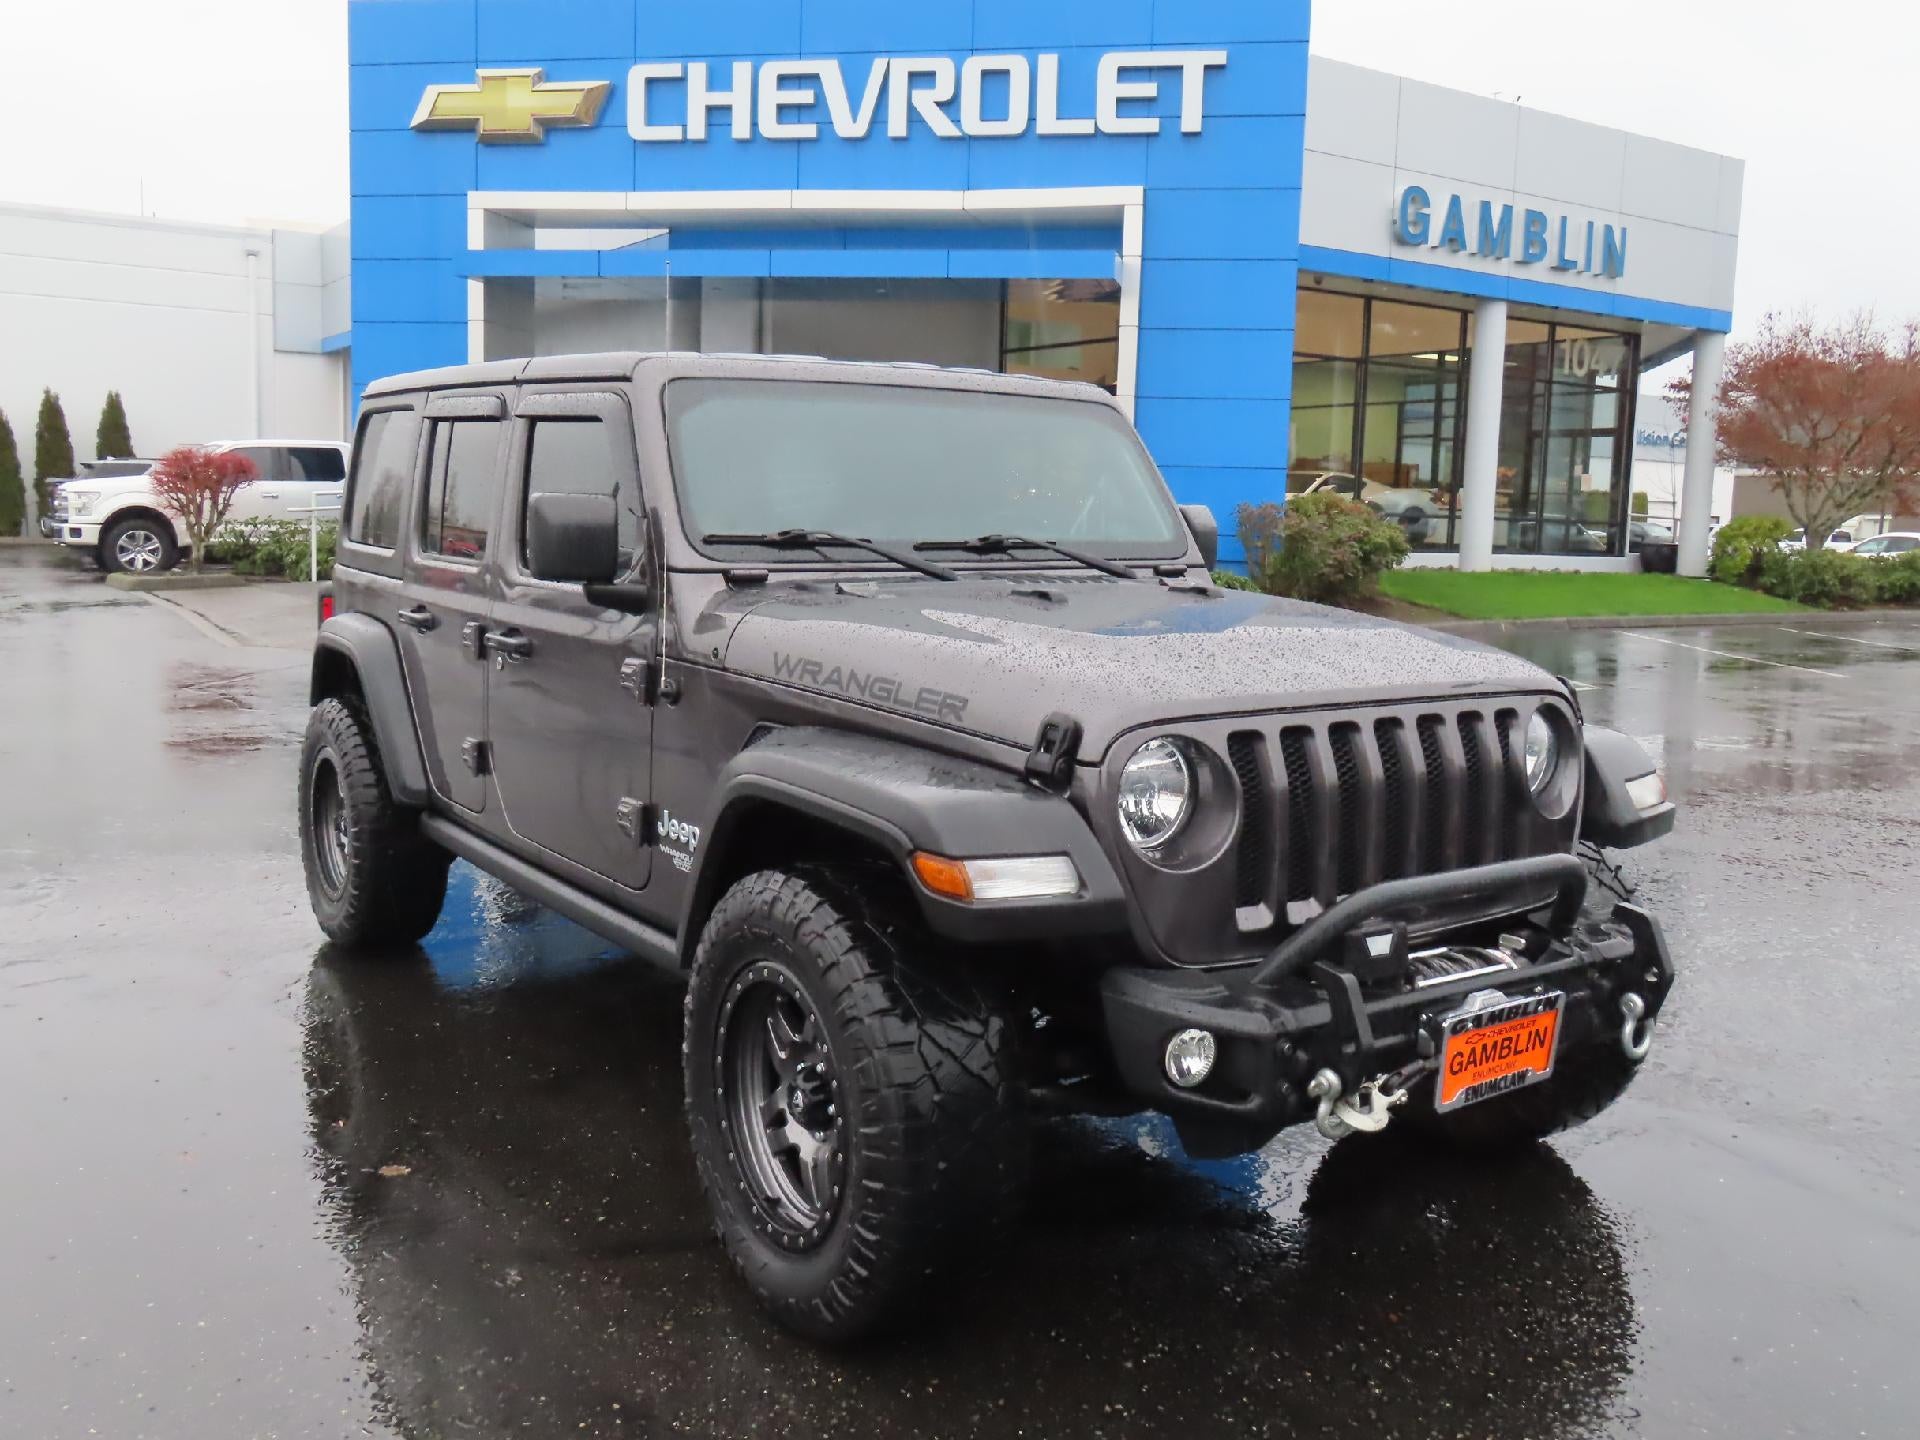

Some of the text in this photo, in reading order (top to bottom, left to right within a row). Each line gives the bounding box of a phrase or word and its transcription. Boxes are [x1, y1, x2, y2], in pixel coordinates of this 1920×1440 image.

[625, 49, 1228, 142] CHEVROLET
[1395, 185, 1627, 279] GAMBLIN
[773, 652, 968, 722] WRANGLER
[657, 809, 700, 853] Jeep
[1449, 994, 1559, 1036] GAMBLIN
[1486, 1019, 1537, 1038] CHEVROLET
[1449, 1026, 1548, 1076] GAMBLIN
[1464, 1068, 1529, 1103] ENUMCLAW
